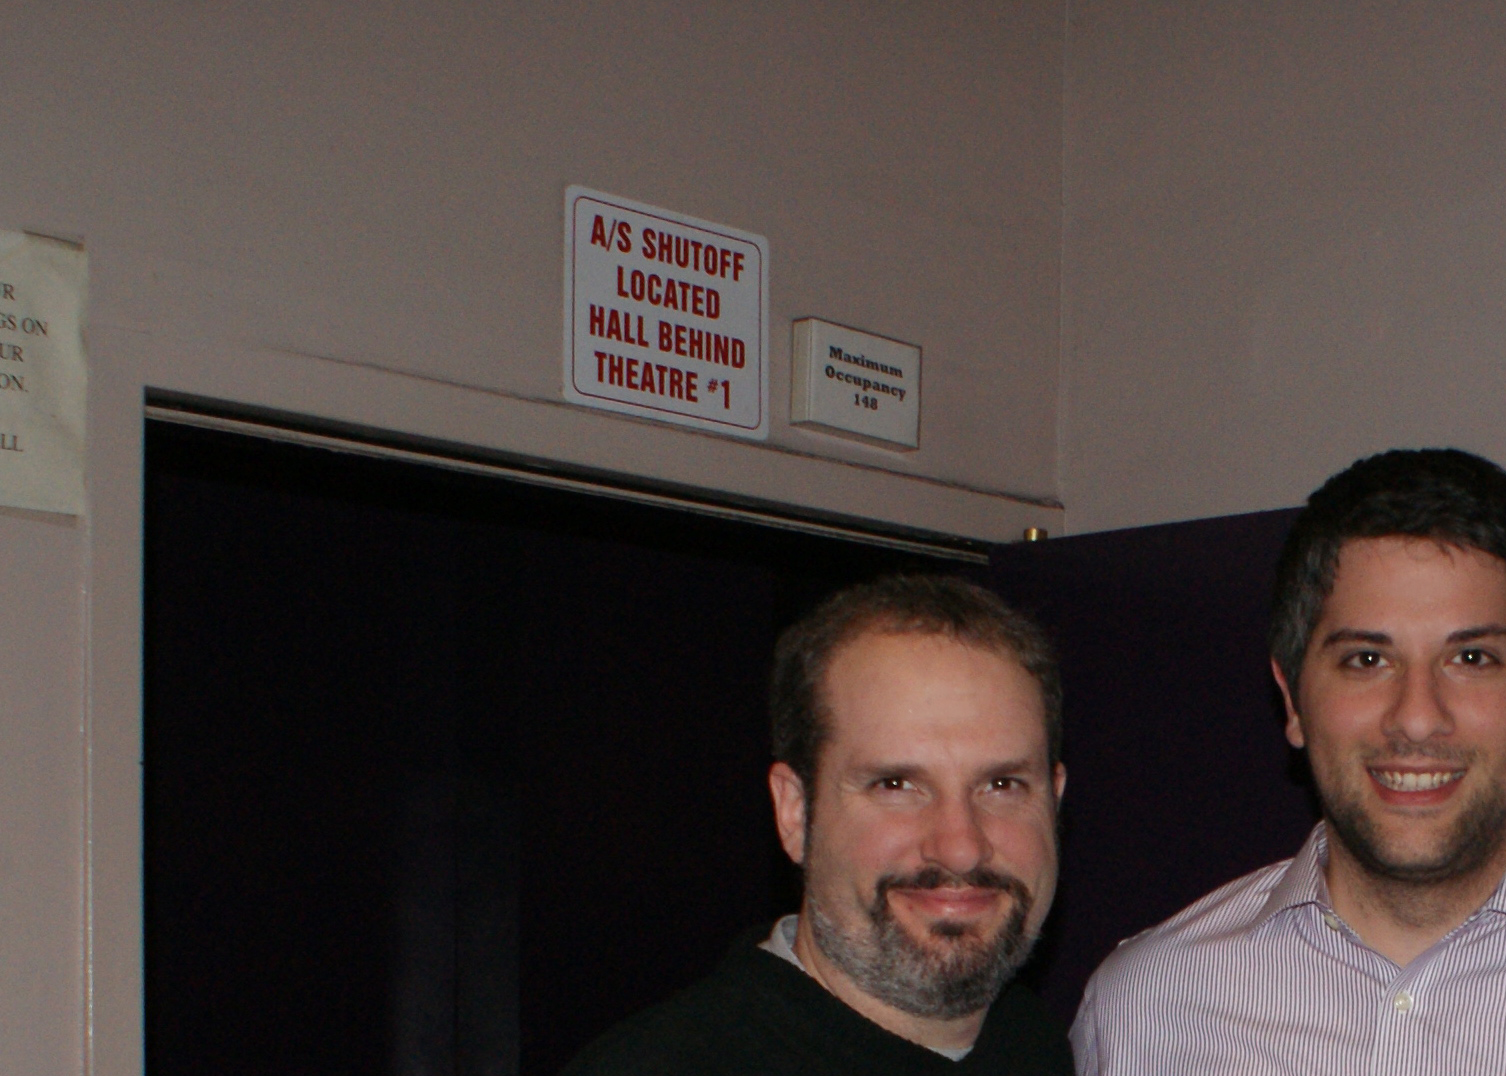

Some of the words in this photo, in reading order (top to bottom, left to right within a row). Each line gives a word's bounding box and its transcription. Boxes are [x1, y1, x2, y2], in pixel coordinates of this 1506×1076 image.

[591, 214, 632, 253] A/S
[642, 228, 745, 282] SHUTOFF
[616, 265, 720, 320] LOCATED
[22, 317, 47, 336] ON
[589, 303, 649, 348] HALL
[658, 320, 746, 369] BEHIND
[594, 350, 698, 403] THEATRE
[707, 378, 730, 409] #1
[824, 365, 906, 401] Occupancy
[829, 345, 903, 378] Maximum
[854, 394, 878, 410] 148
